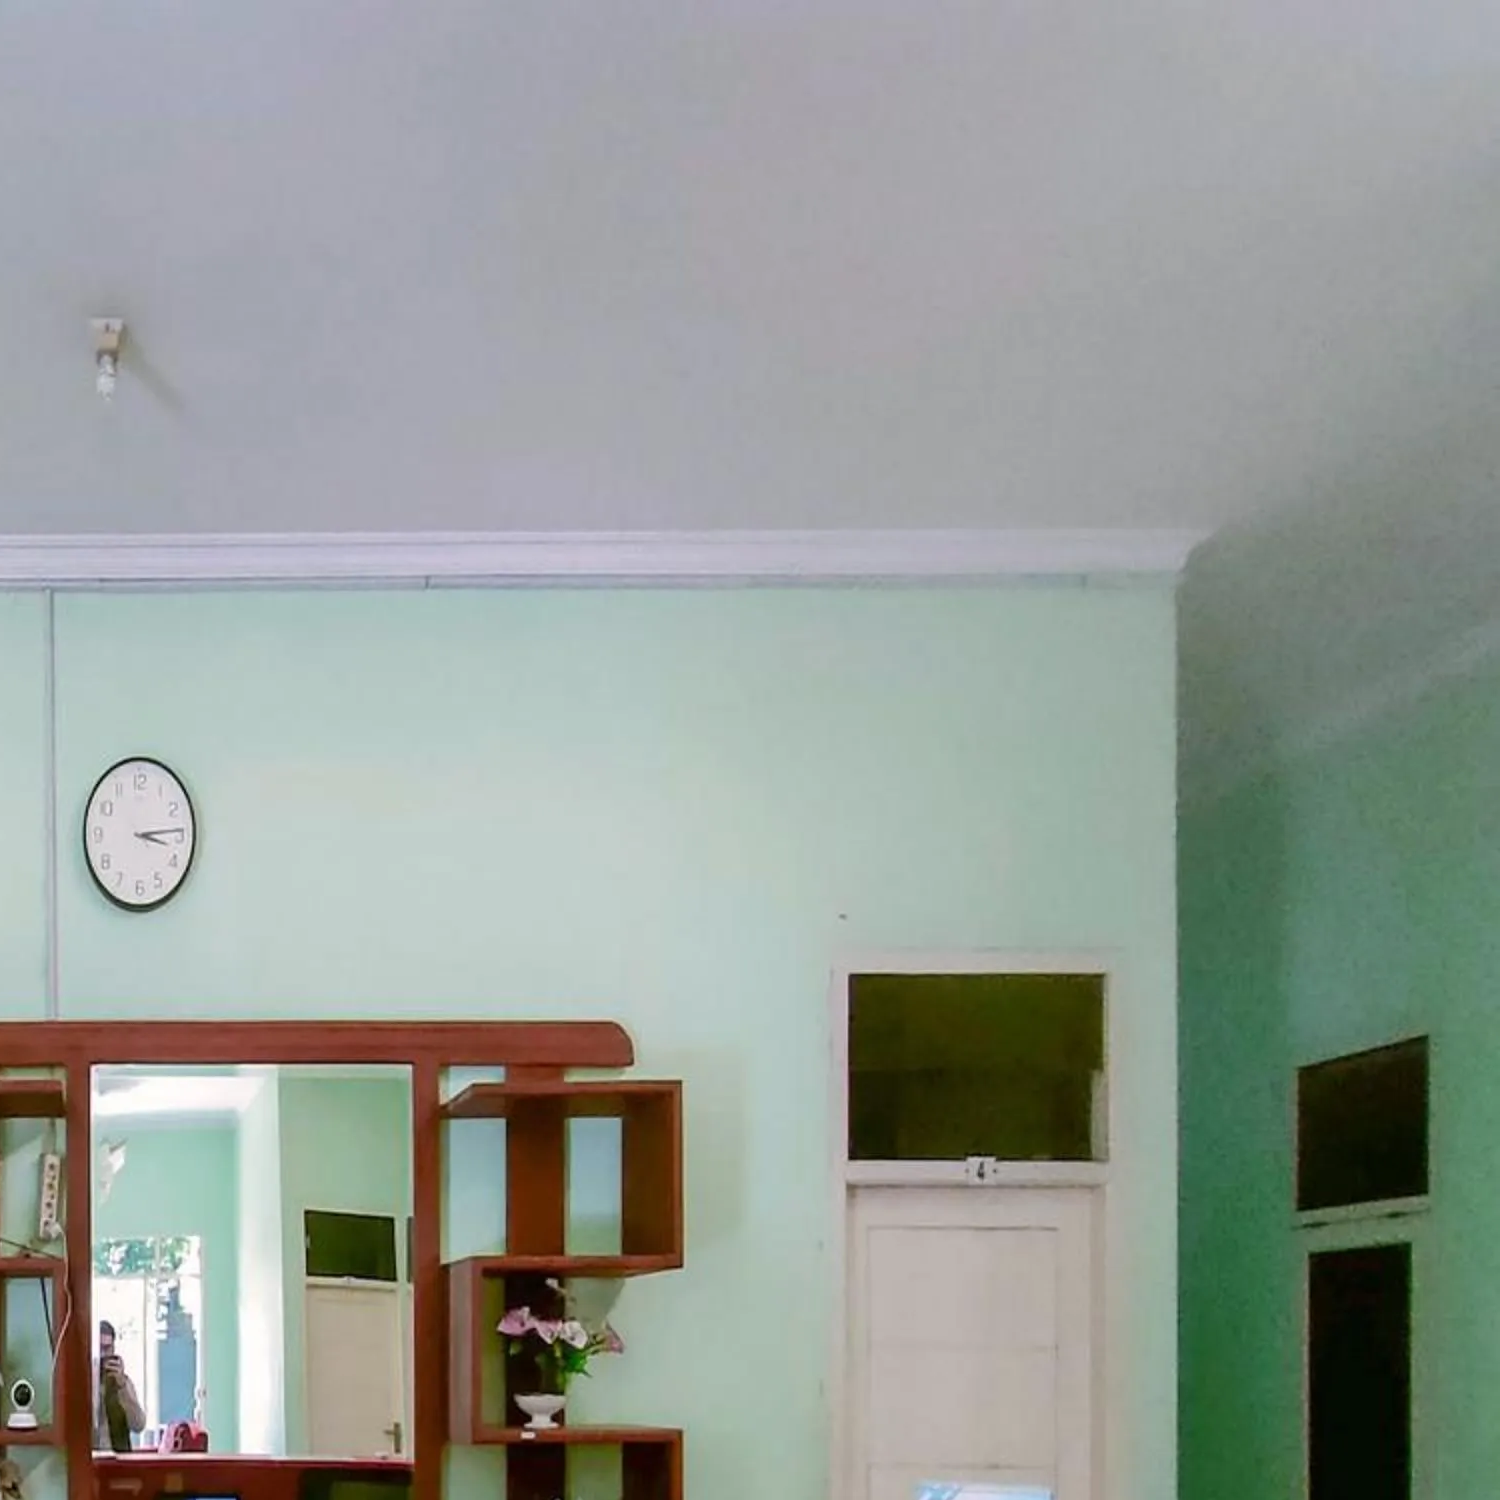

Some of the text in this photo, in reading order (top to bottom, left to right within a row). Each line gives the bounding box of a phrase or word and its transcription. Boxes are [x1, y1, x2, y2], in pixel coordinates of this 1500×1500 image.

[115, 783, 123, 797] 11
[133, 774, 147, 791] 12
[100, 801, 113, 817] 10
[168, 801, 179, 818] 2
[93, 826, 103, 844] 9
[101, 853, 111, 870] 8
[168, 853, 178, 869] 4
[116, 872, 124, 887] 7
[153, 872, 163, 889] 5
[135, 880, 145, 897] 6
